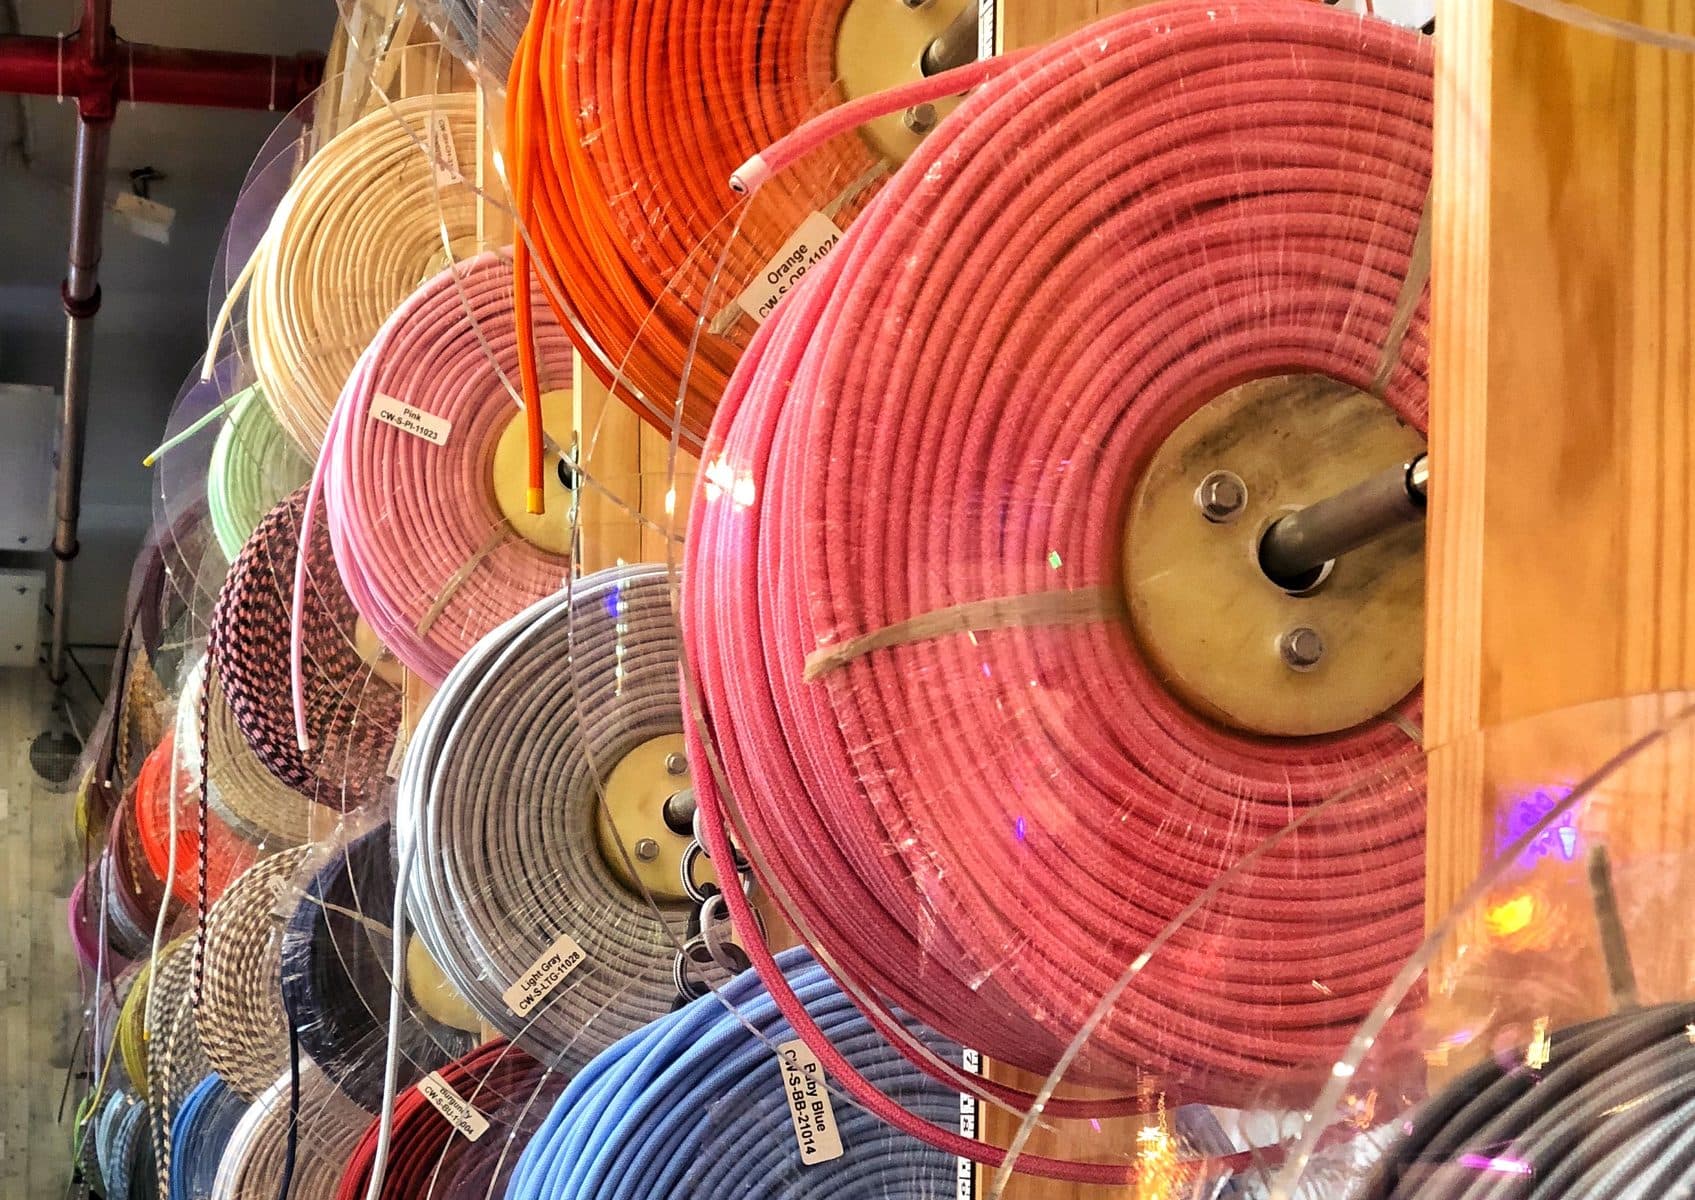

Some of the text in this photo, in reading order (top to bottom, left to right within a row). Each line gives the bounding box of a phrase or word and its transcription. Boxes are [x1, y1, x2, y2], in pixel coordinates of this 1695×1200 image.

[767, 244, 808, 285] Orange
[380, 410, 438, 440] CW-S-PI-11023
[403, 408, 421, 422] Pink
[519, 951, 580, 1010] CW-S-LTG-11028
[520, 954, 562, 991] Light Gray
[424, 1086, 474, 1135] CW-S-BU-1004
[804, 1062, 826, 1132] Bby Blue
